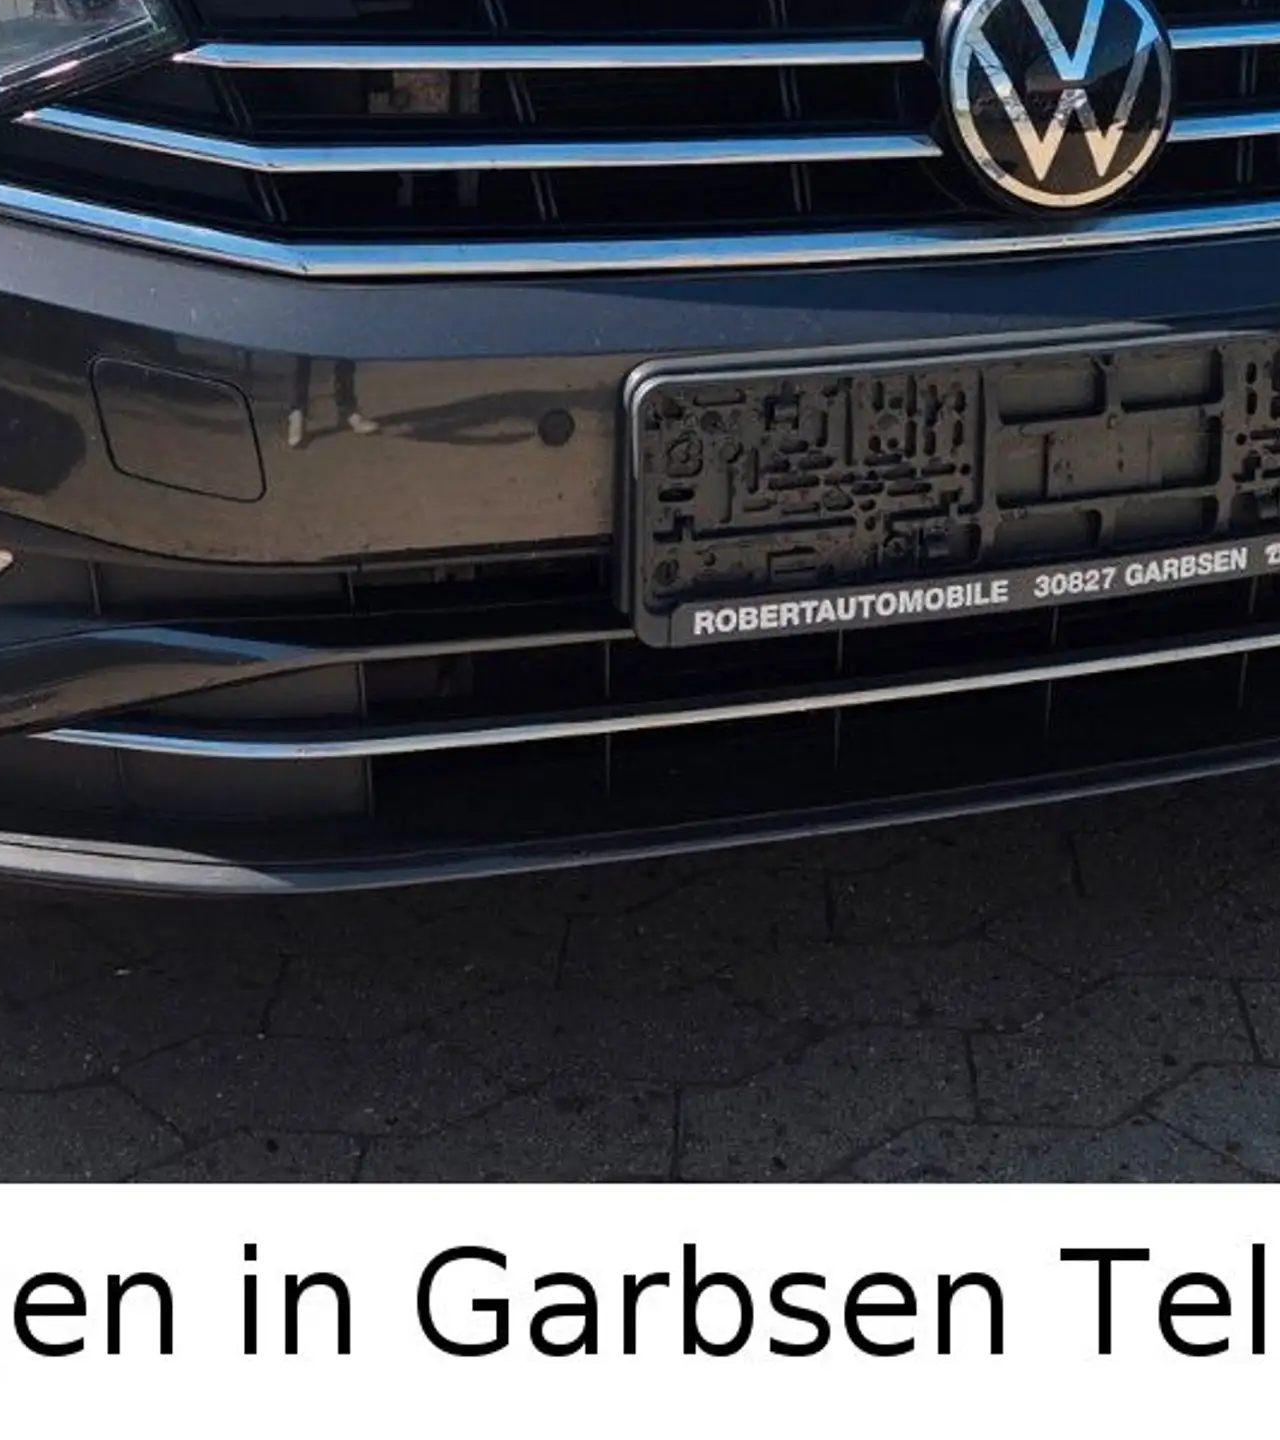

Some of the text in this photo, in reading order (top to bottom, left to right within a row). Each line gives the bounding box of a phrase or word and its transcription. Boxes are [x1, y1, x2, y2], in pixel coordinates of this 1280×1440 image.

[693, 579, 1009, 636] ROBERTAUTOMOBILE
[1033, 566, 1117, 599] 30827
[1124, 547, 1248, 588] GARBSEN
